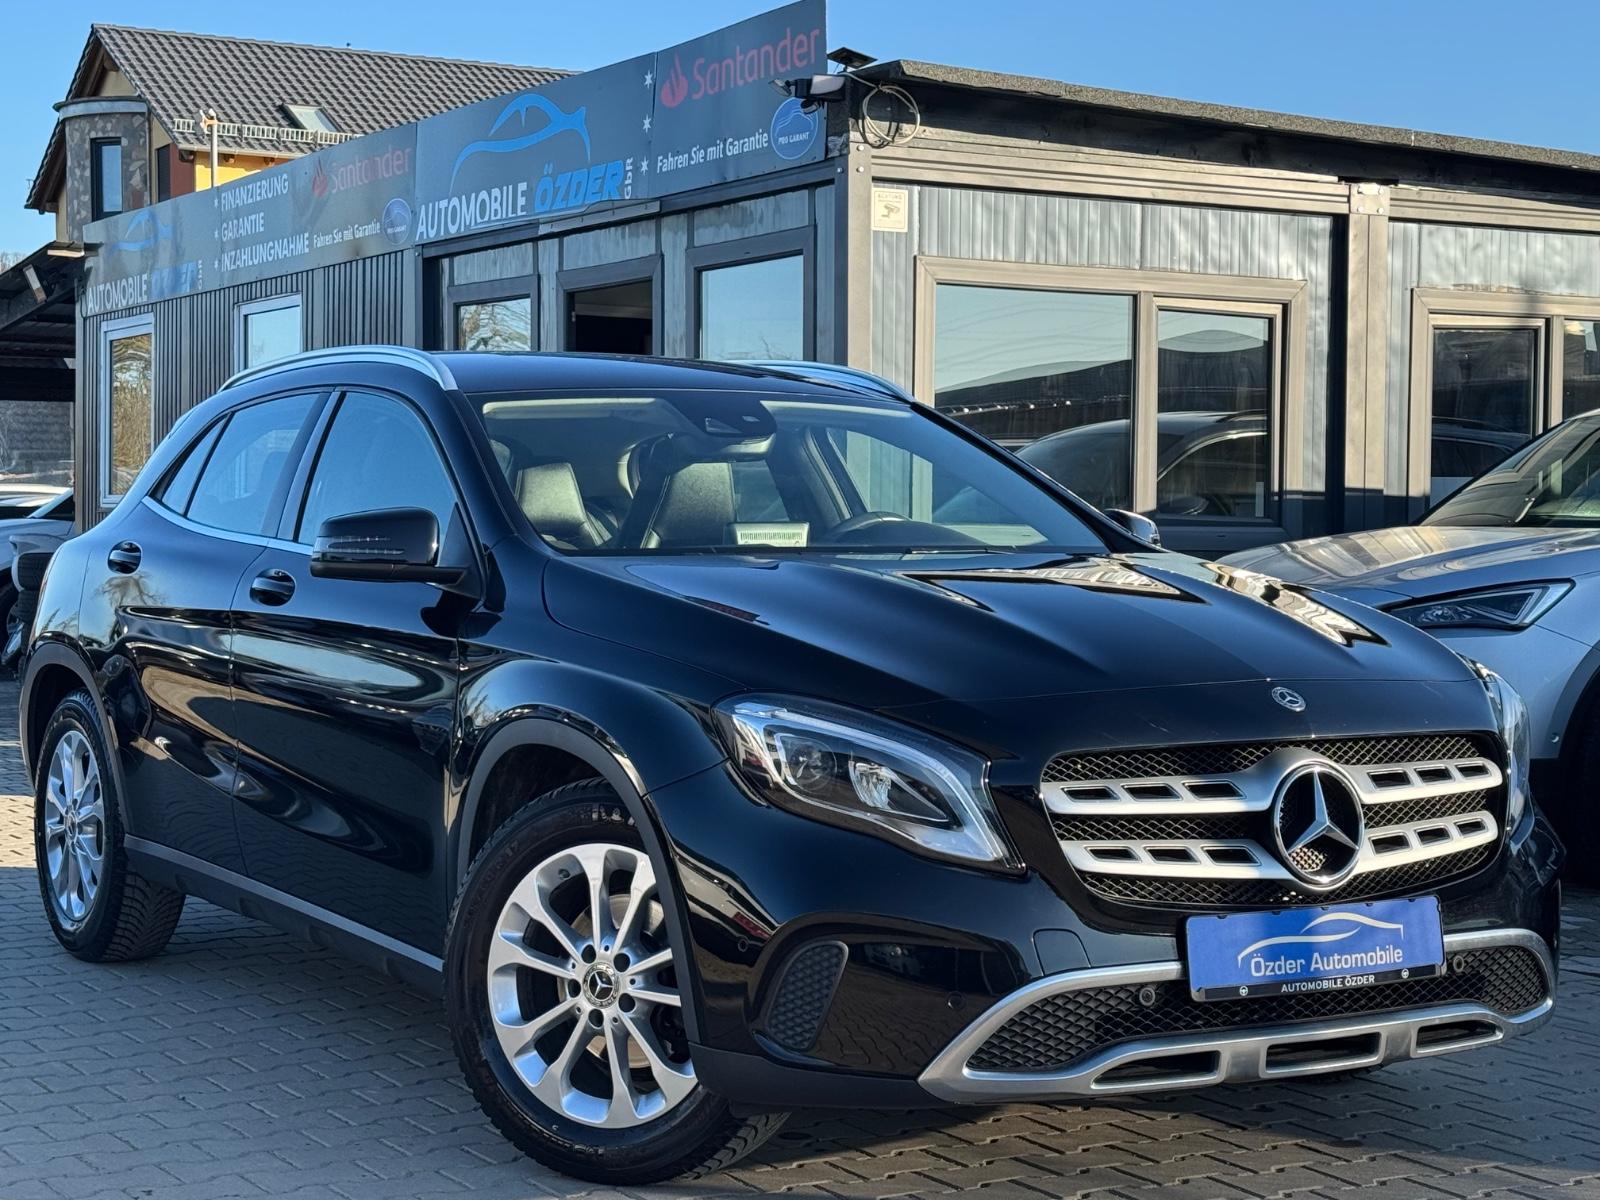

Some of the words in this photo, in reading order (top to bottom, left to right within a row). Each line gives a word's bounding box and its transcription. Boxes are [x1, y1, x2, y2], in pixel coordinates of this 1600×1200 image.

[692, 27, 820, 100] Santander
[330, 144, 412, 194] Santander
[657, 151, 689, 173] Fahren
[690, 144, 705, 165] Sie
[706, 140, 723, 161] mit
[725, 129, 769, 156] Garantie
[221, 173, 289, 212] FINANZIERUNG
[624, 157, 634, 199] GbR
[416, 181, 528, 240] AUTOMOBILE
[534, 160, 623, 214] ÖZDER
[221, 212, 264, 241] GARANTIE
[313, 232, 333, 248] Fahren
[333, 228, 343, 244] Sie
[343, 225, 354, 241] mit
[354, 218, 381, 239] Garantie
[221, 232, 309, 273] INZAHLUNGNAHME
[87, 273, 148, 315] AUTOMOBILE
[1250, 953, 1305, 977] Özder
[1310, 945, 1403, 971] Automobile
[1281, 977, 1343, 993] AUTOMOBILE
[1345, 974, 1375, 986] ÖZDER
